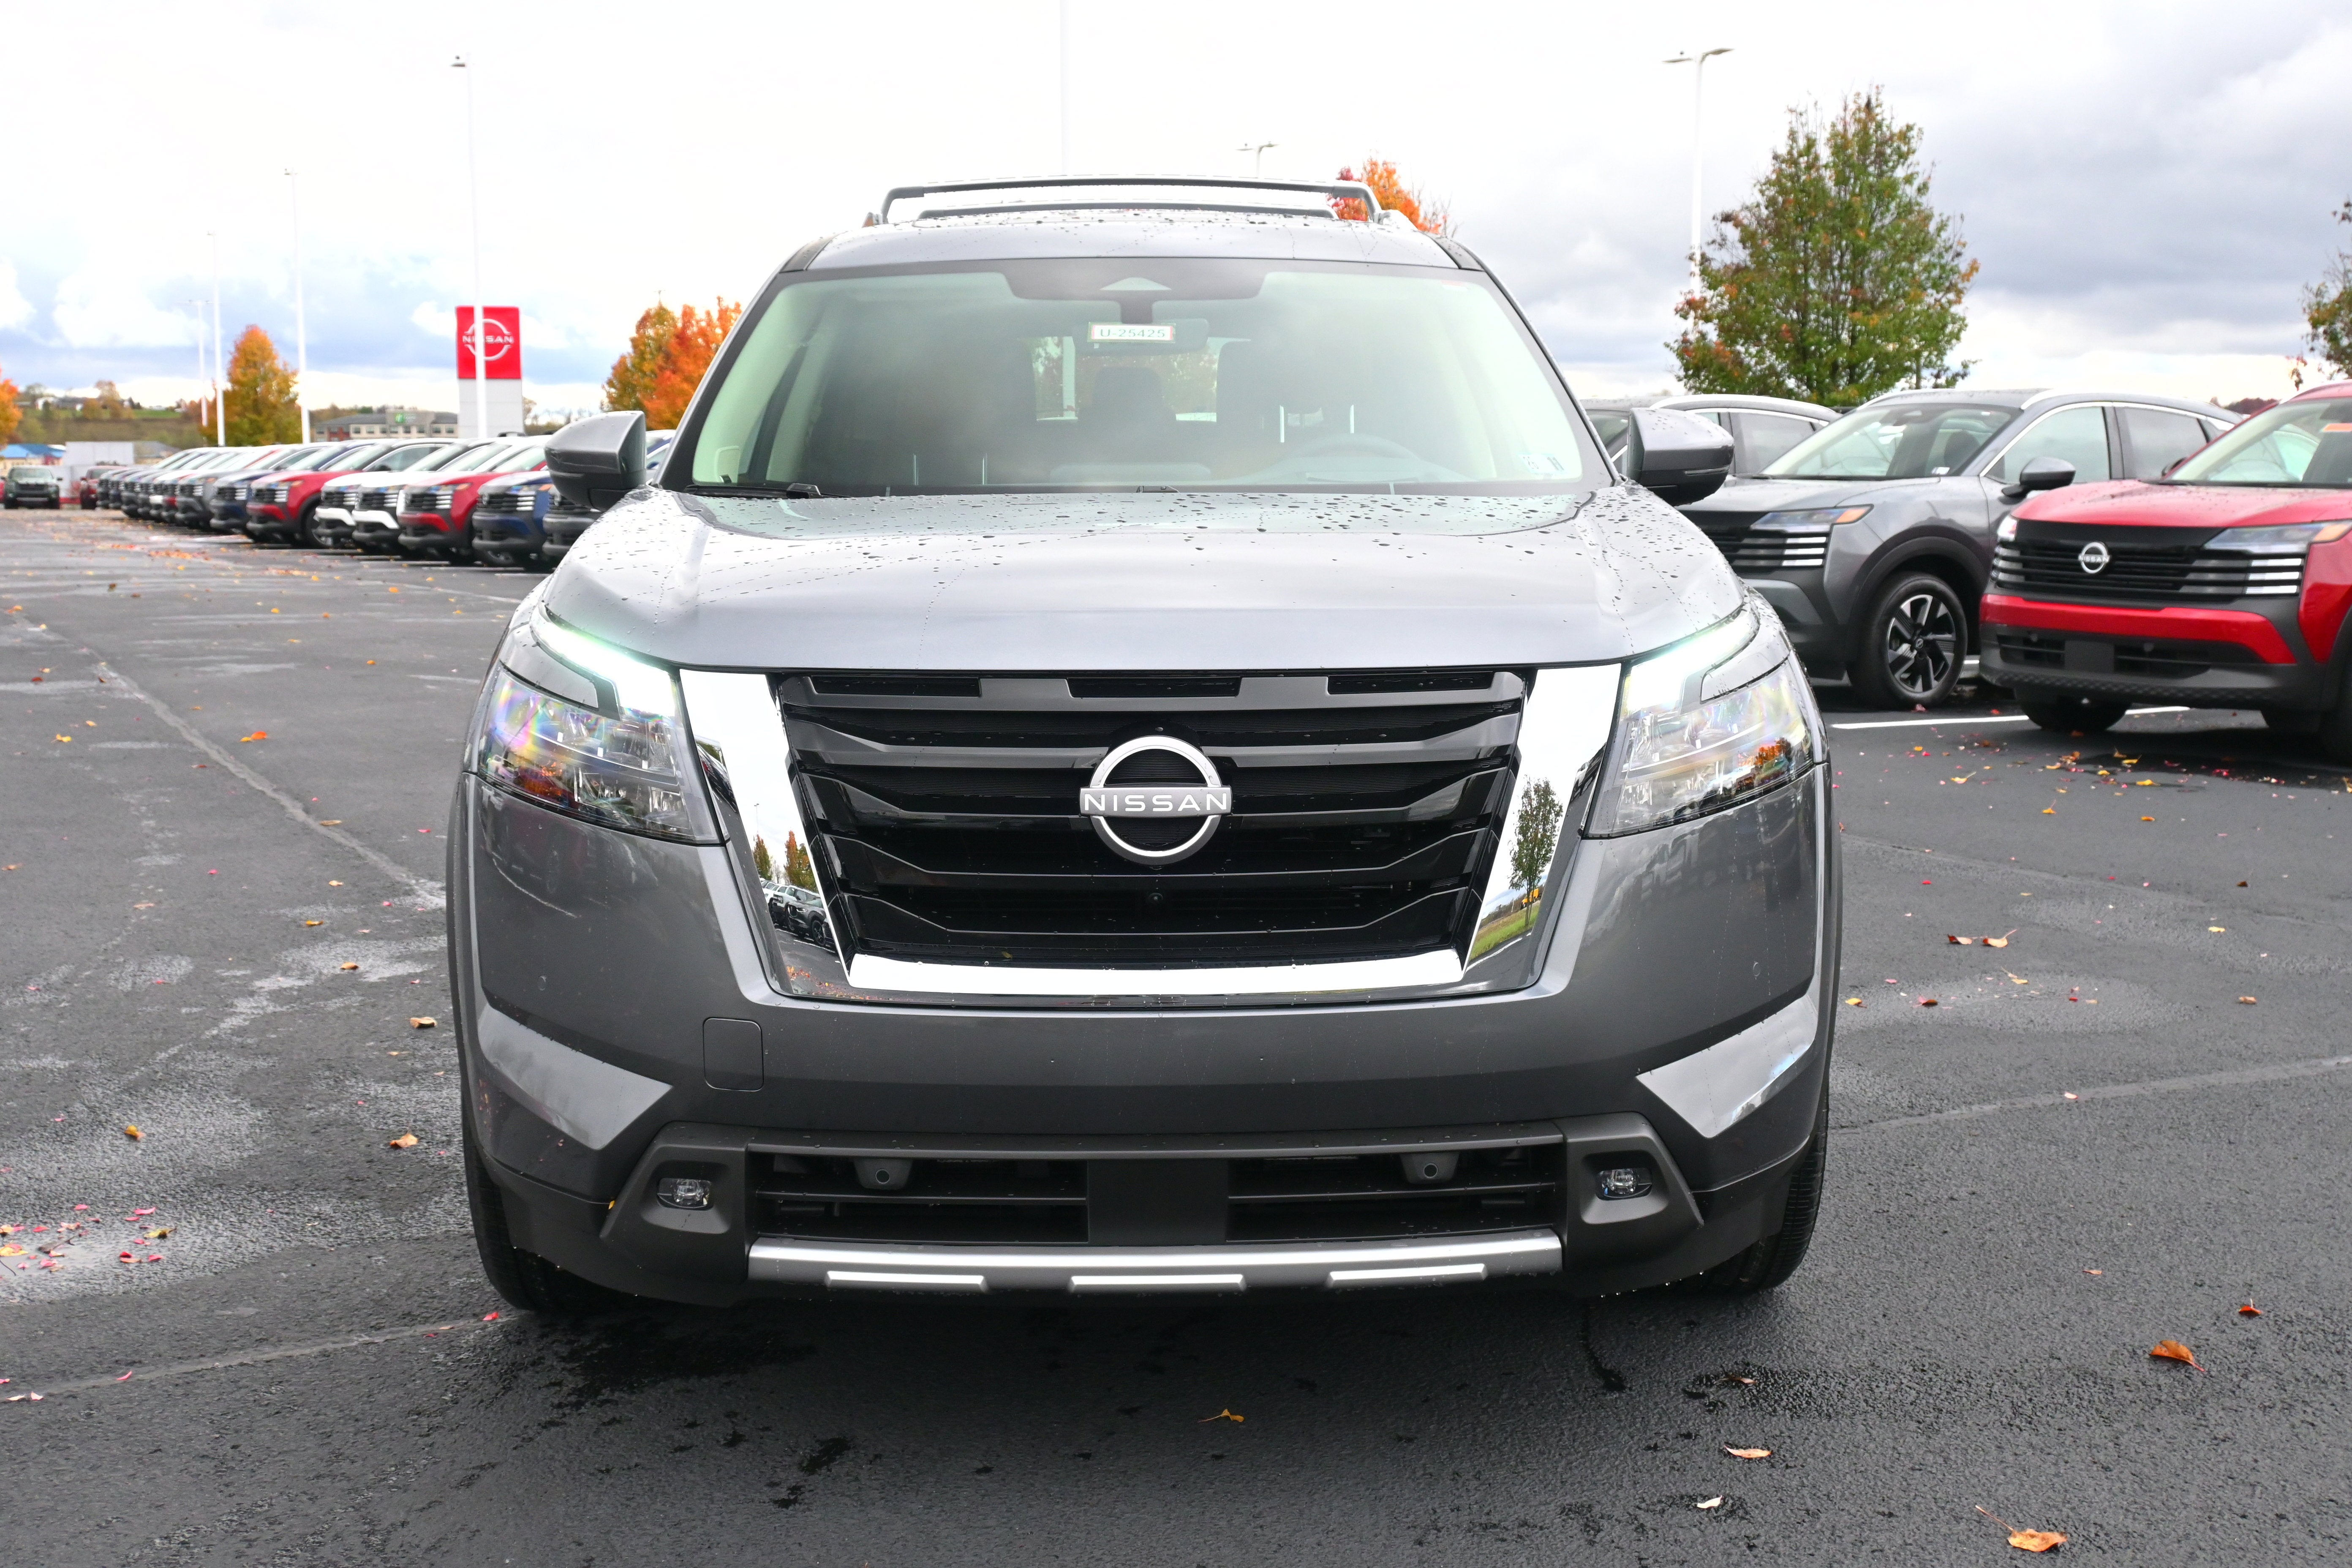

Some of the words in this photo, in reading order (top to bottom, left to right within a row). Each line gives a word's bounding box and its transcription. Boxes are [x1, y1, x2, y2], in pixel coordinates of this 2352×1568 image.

[1100, 329, 1165, 338] U-25425
[463, 335, 513, 343] NISAN
[1084, 793, 1227, 811] NISSAN
